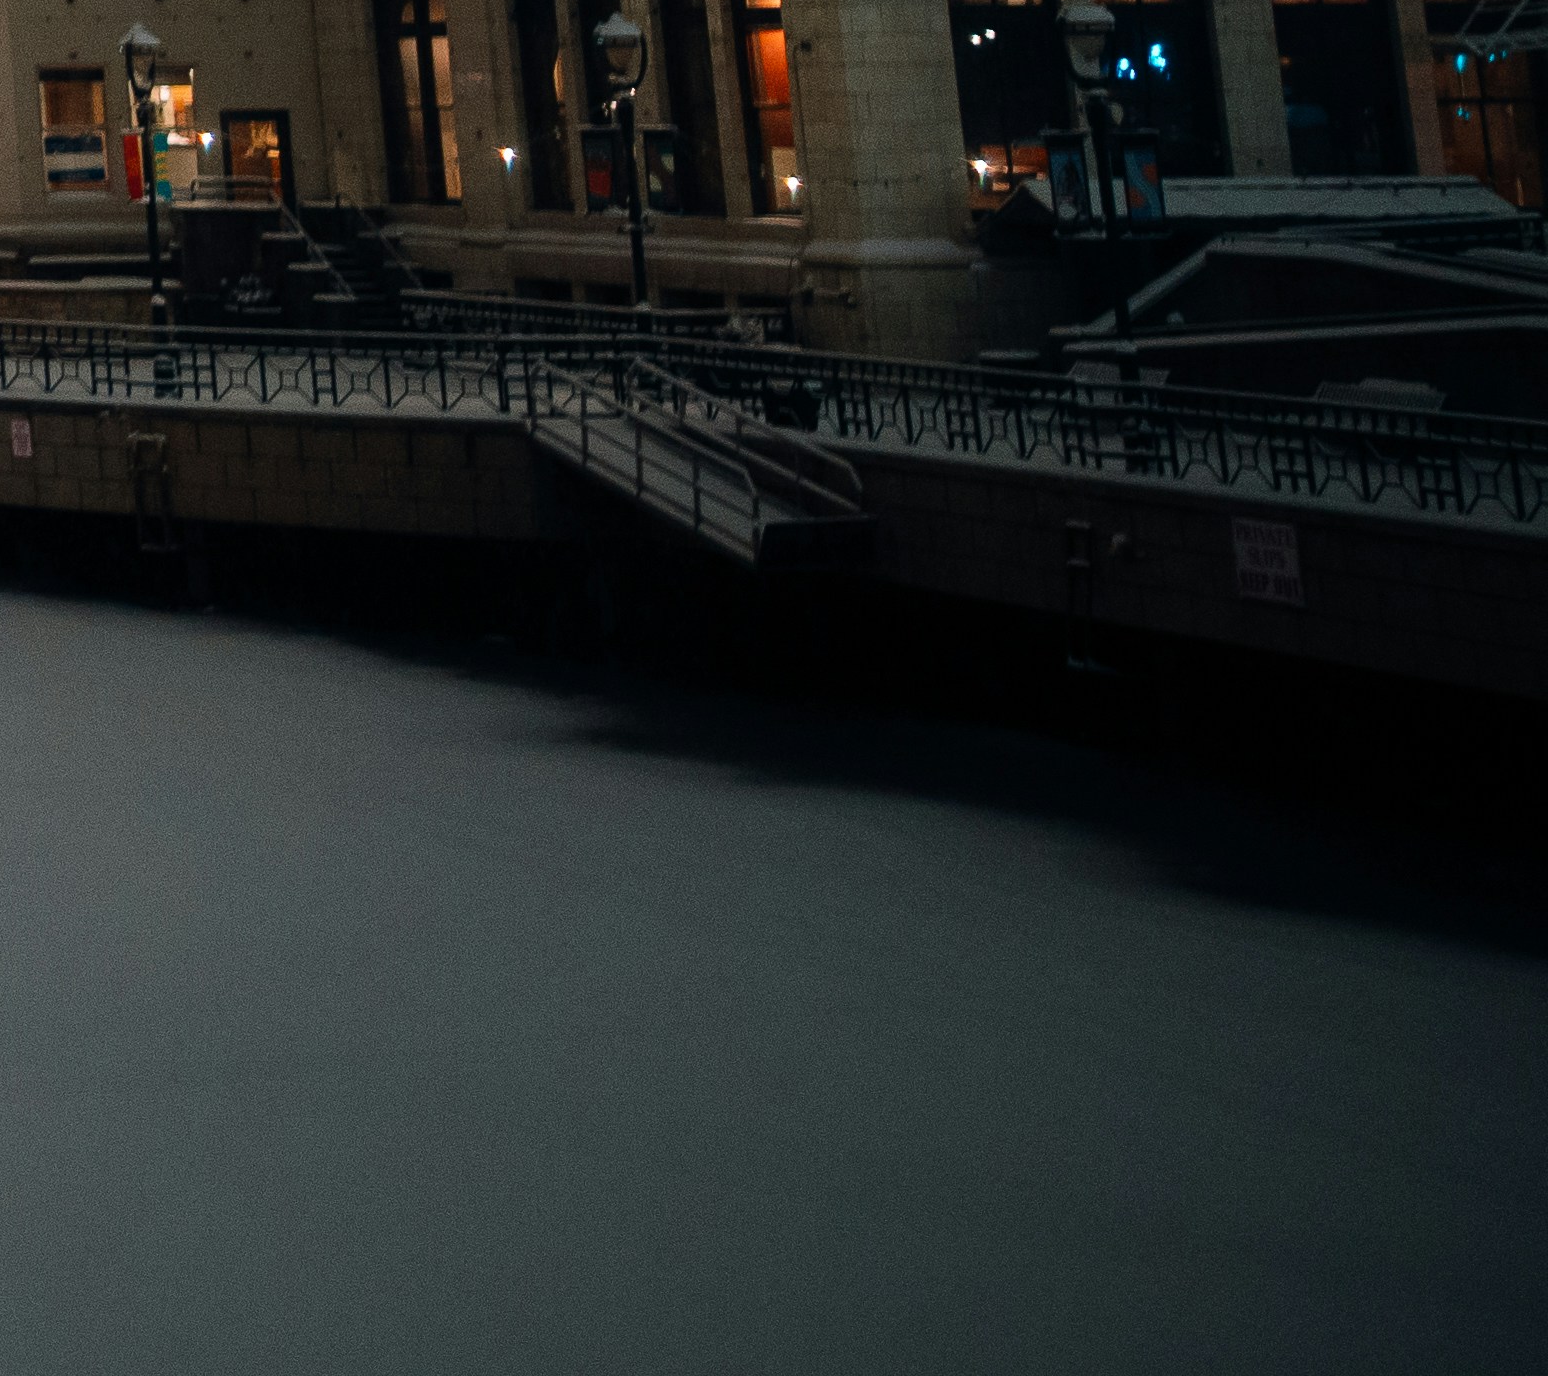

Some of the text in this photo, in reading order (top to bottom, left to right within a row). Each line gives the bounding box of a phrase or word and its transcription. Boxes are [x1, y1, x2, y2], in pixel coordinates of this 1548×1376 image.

[1235, 524, 1293, 546] PRIVATE
[1241, 570, 1300, 598] KEEP OUT
